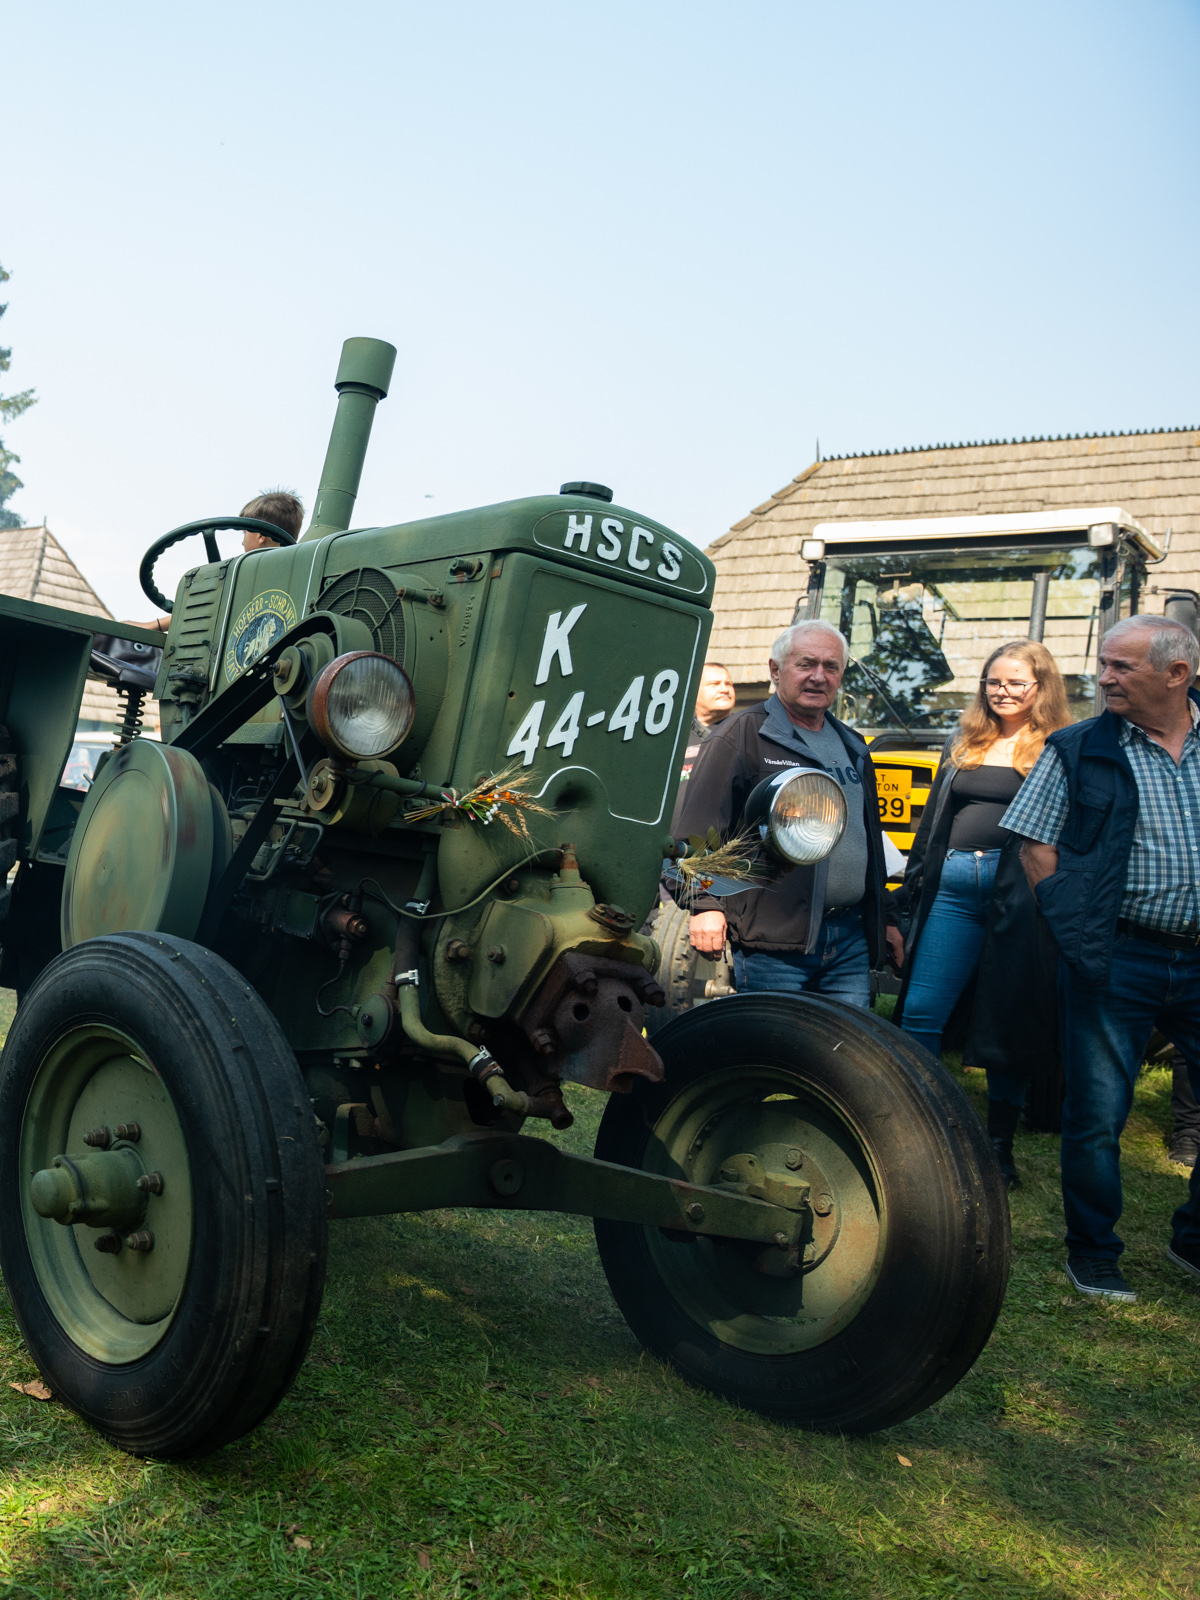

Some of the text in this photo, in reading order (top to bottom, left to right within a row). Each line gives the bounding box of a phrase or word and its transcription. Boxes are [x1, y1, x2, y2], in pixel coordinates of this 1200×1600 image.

[563, 514, 683, 581] HSCS
[535, 603, 587, 686] K
[506, 669, 679, 766] 44-48
